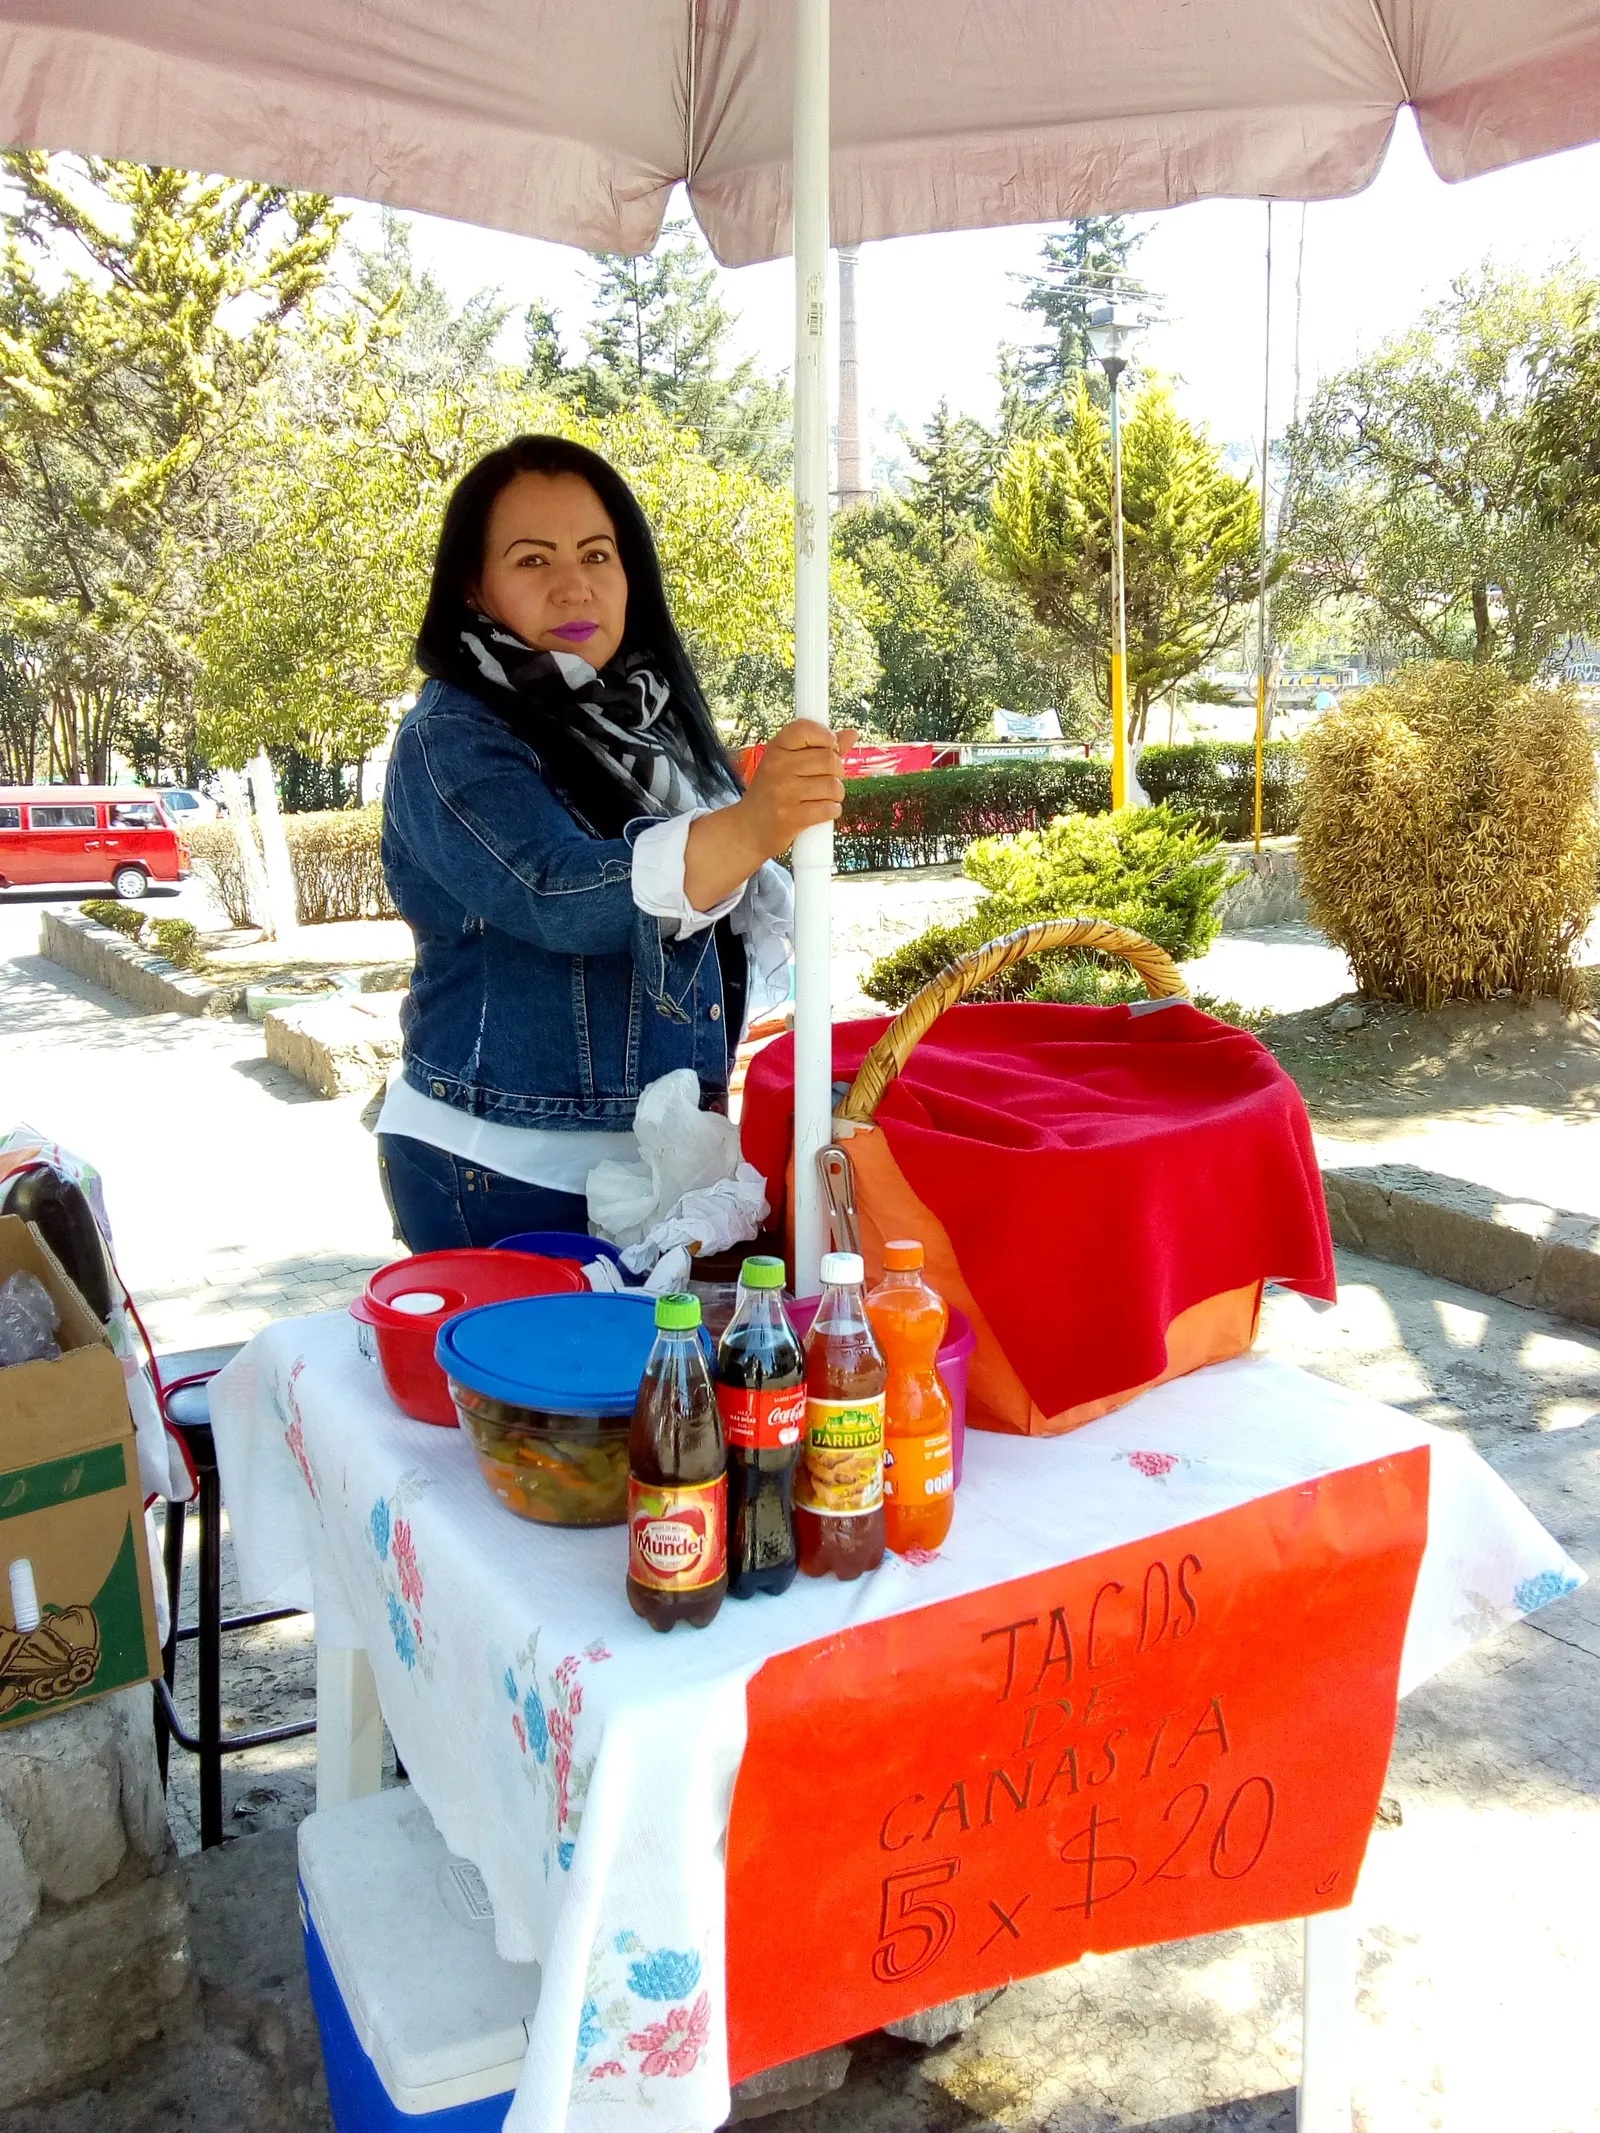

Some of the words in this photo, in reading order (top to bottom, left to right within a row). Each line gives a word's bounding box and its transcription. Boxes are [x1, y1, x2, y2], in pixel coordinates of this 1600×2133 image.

[1023, 746, 1047, 756] ROSY
[814, 1428, 880, 1447] JARRITOS
[981, 1553, 1203, 1704] TACOS
[1012, 1673, 1138, 1757] DE
[878, 1693, 1230, 1852] CANASTA
[871, 1856, 961, 1984] 5
